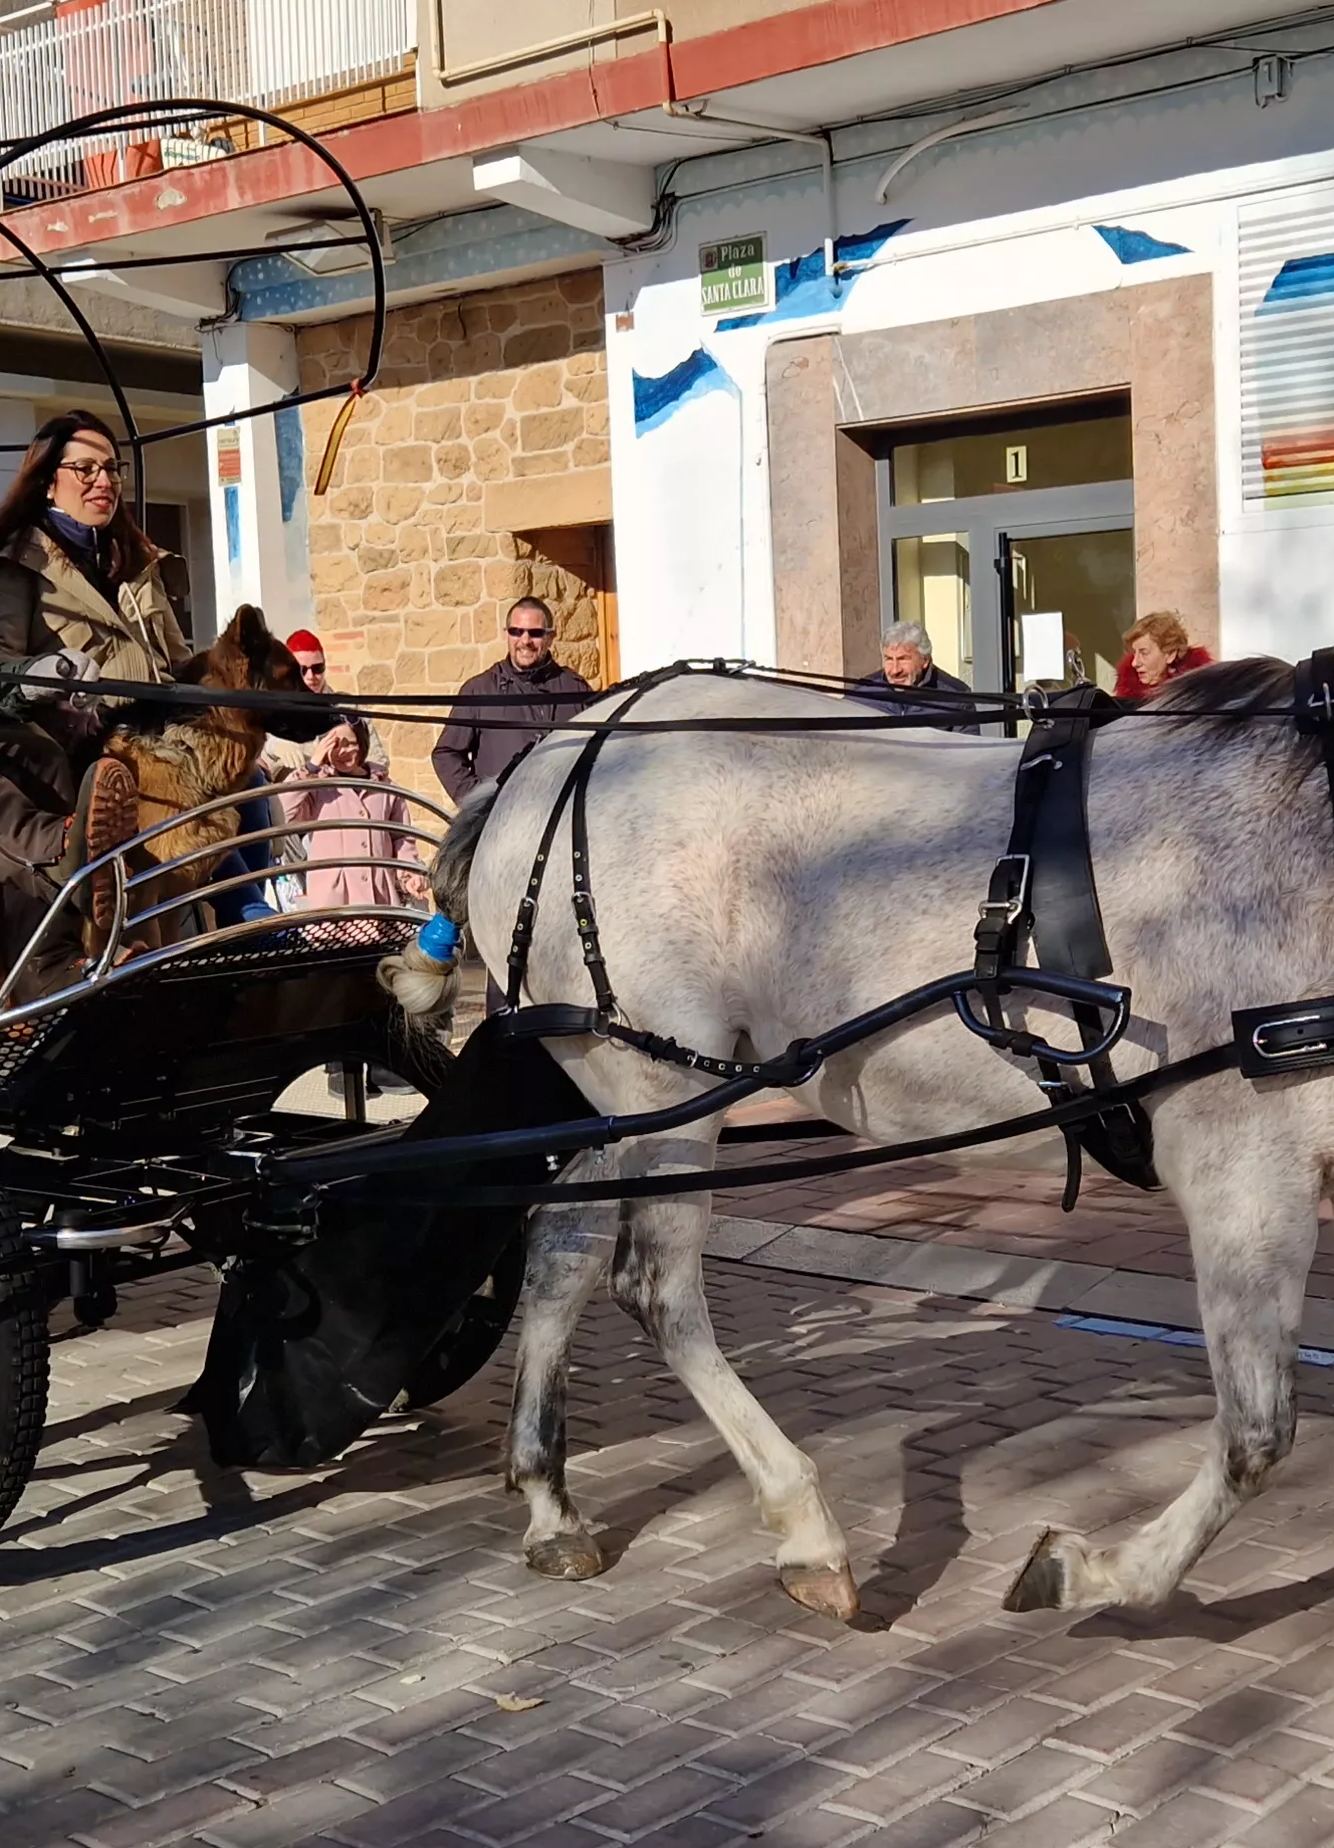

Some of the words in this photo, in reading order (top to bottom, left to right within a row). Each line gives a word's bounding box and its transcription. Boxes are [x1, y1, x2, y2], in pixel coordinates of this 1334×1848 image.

[721, 244, 755, 262] Plaza
[728, 263, 742, 278] de
[701, 282, 731, 304] SANTA
[732, 276, 764, 299] CLARA
[1011, 451, 1023, 478] 1
